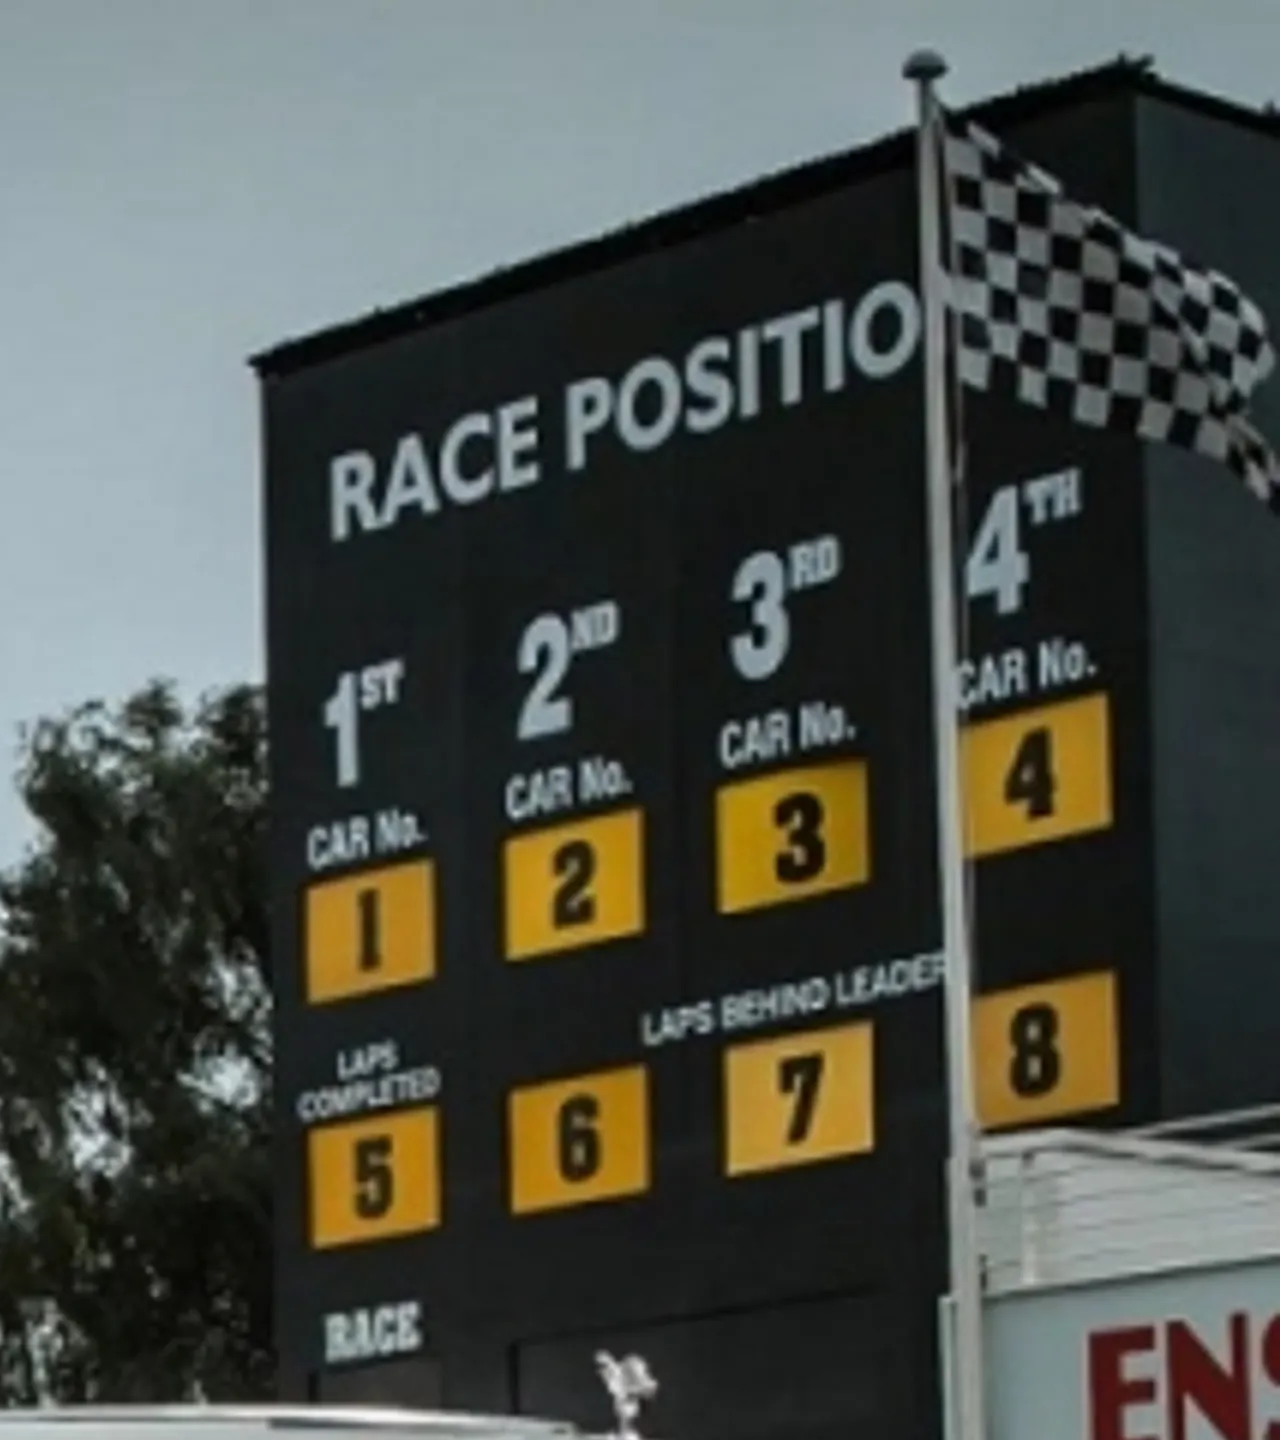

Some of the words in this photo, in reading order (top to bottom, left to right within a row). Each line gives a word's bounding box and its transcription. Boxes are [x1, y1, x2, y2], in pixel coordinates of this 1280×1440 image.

[330, 395, 540, 542] RACE
[966, 467, 1081, 615] 4TH
[730, 534, 840, 681] 3RD
[517, 599, 619, 740] 2ND
[324, 658, 404, 787] 1ST
[719, 708, 789, 769] CAR
[799, 701, 856, 749] No.
[505, 765, 572, 822] CAR
[578, 755, 633, 801] No.
[1004, 725, 1056, 821] 4
[307, 815, 370, 872] CAR
[775, 792, 825, 884] 3
[358, 888, 382, 972] 1
[553, 839, 596, 931] 2
[642, 1001, 716, 1047] LAPS
[721, 976, 831, 1032] BEHIND
[1010, 1002, 1060, 1100] 8
[296, 1065, 441, 1124] COMPLETED
[337, 1038, 399, 1082] LAPS
[778, 1052, 824, 1145] 7
[354, 1132, 394, 1220] 5
[557, 1094, 601, 1184] 6
[324, 1300, 422, 1365] RACE
